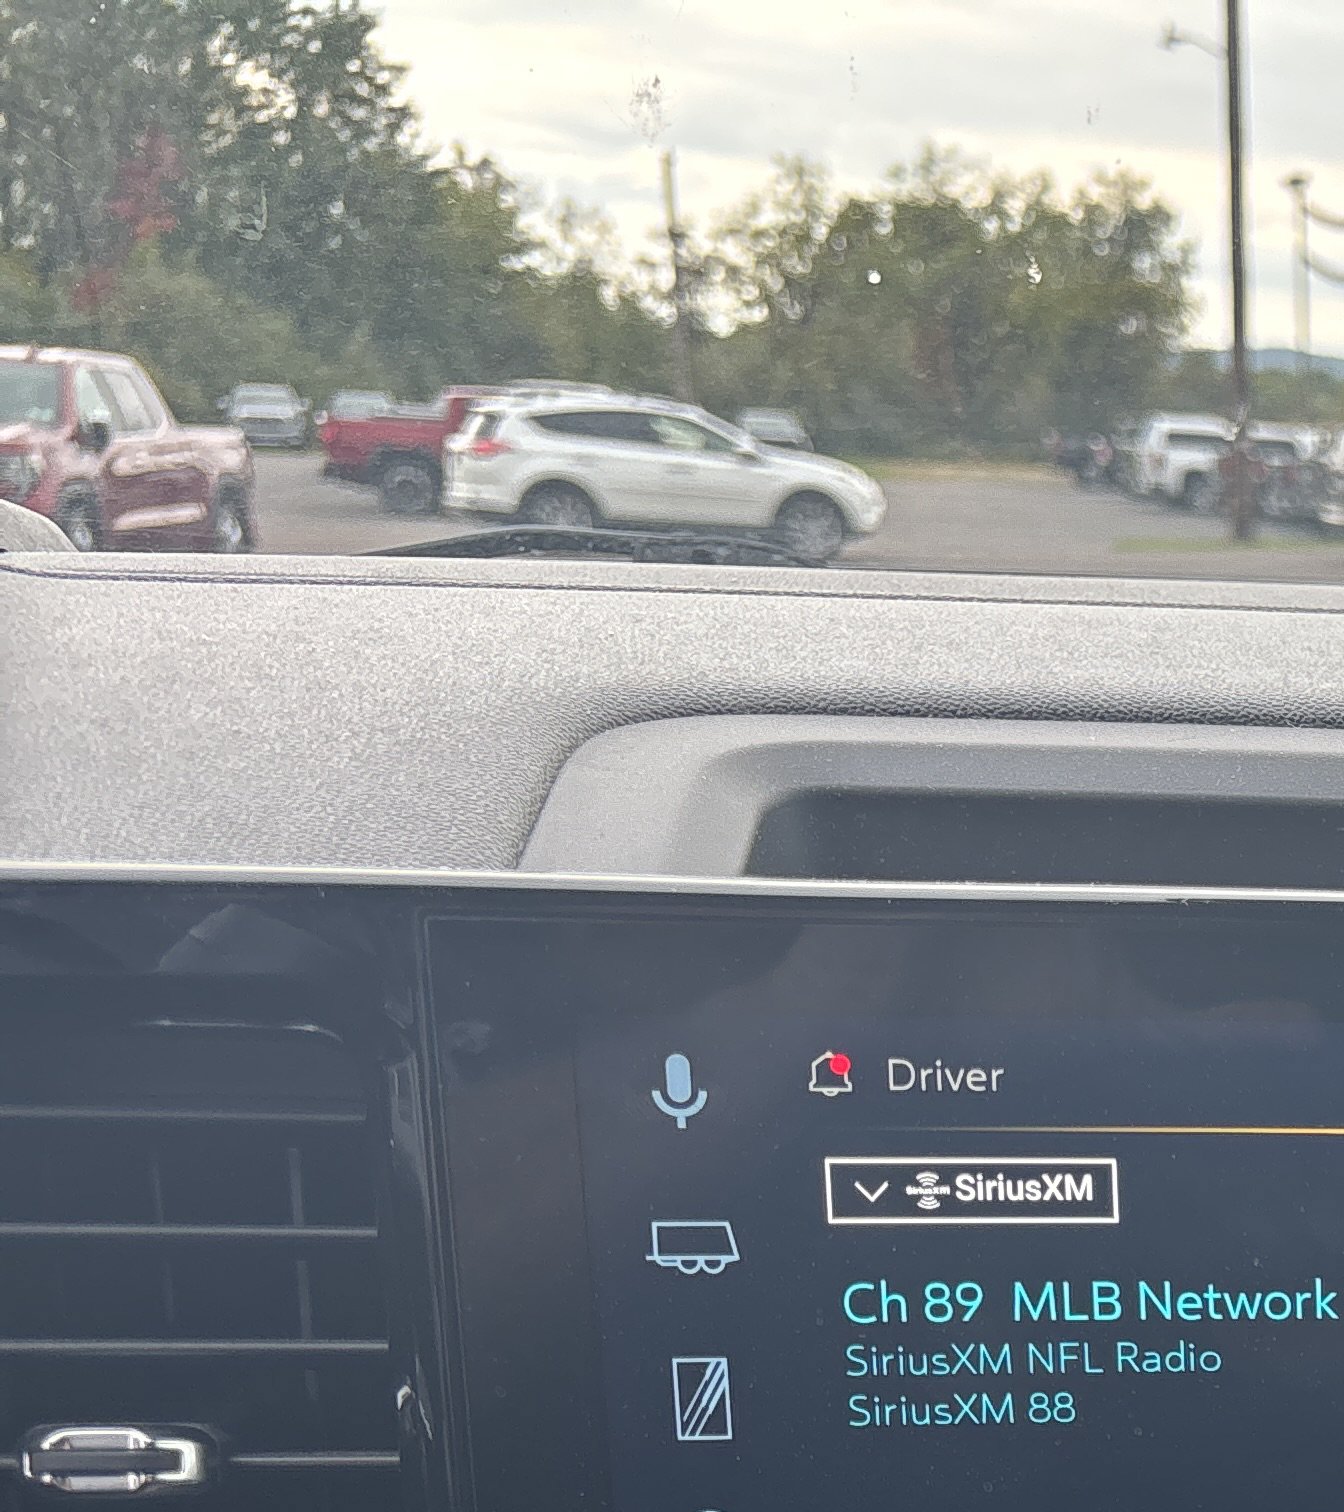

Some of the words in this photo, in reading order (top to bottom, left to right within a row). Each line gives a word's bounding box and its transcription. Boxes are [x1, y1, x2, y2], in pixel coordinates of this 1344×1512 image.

[887, 1058, 1005, 1092] Driver
[955, 1172, 1094, 1202] SiriusXM
[843, 1279, 908, 1324] Ch
[924, 1281, 984, 1323] 89
[1014, 1280, 1122, 1322] MLB
[1138, 1277, 1339, 1321] Network
[846, 1343, 1013, 1377] SiriusXM
[1027, 1341, 1104, 1374] NFL
[1116, 1339, 1222, 1373] Radio
[849, 1392, 1015, 1427] SiriusXM
[1028, 1391, 1076, 1424] 88
